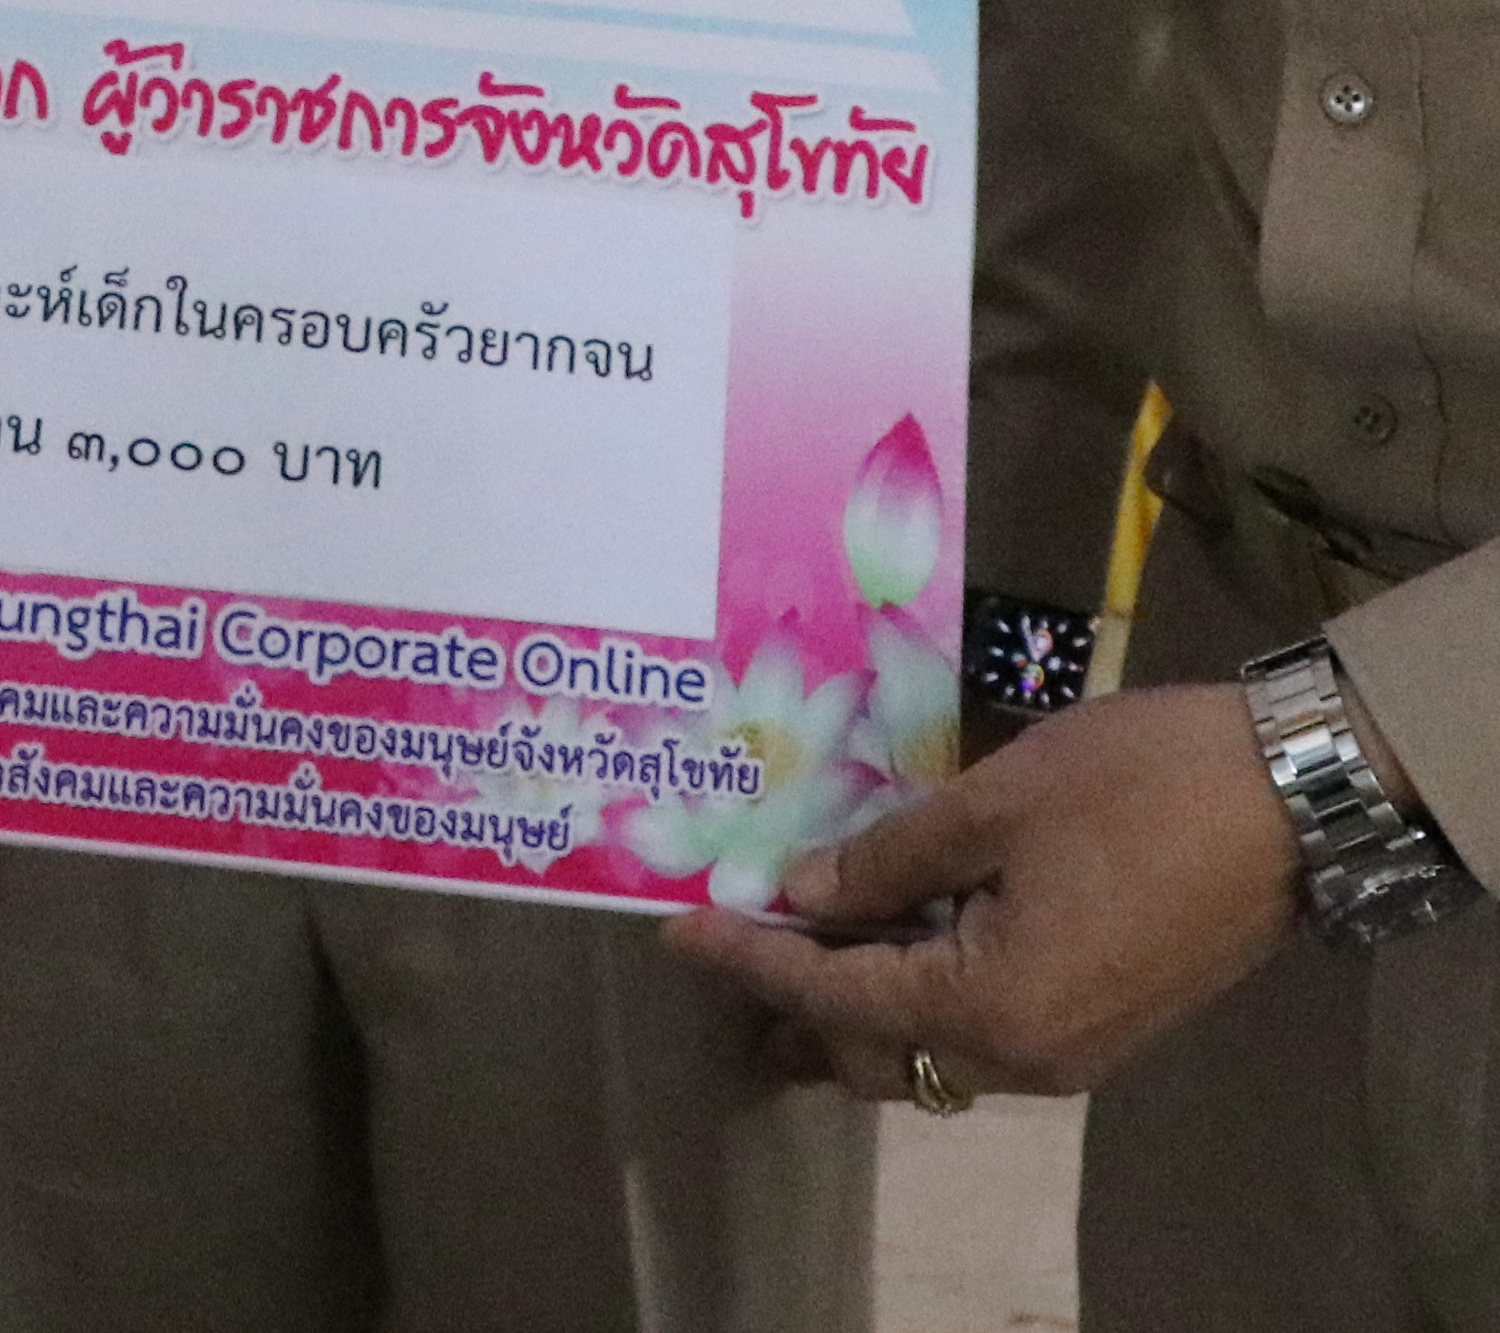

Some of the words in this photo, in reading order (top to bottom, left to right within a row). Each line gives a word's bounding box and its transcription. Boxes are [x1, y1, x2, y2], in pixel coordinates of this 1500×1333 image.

[80, 38, 930, 219] ผู้ว่าราชการจังหวัดสุโขทัย
[67, 429, 247, 477] ๓,๐๐๐
[273, 439, 382, 489] บาท
[220, 609, 498, 681] Corporate
[521, 639, 706, 703] Online
